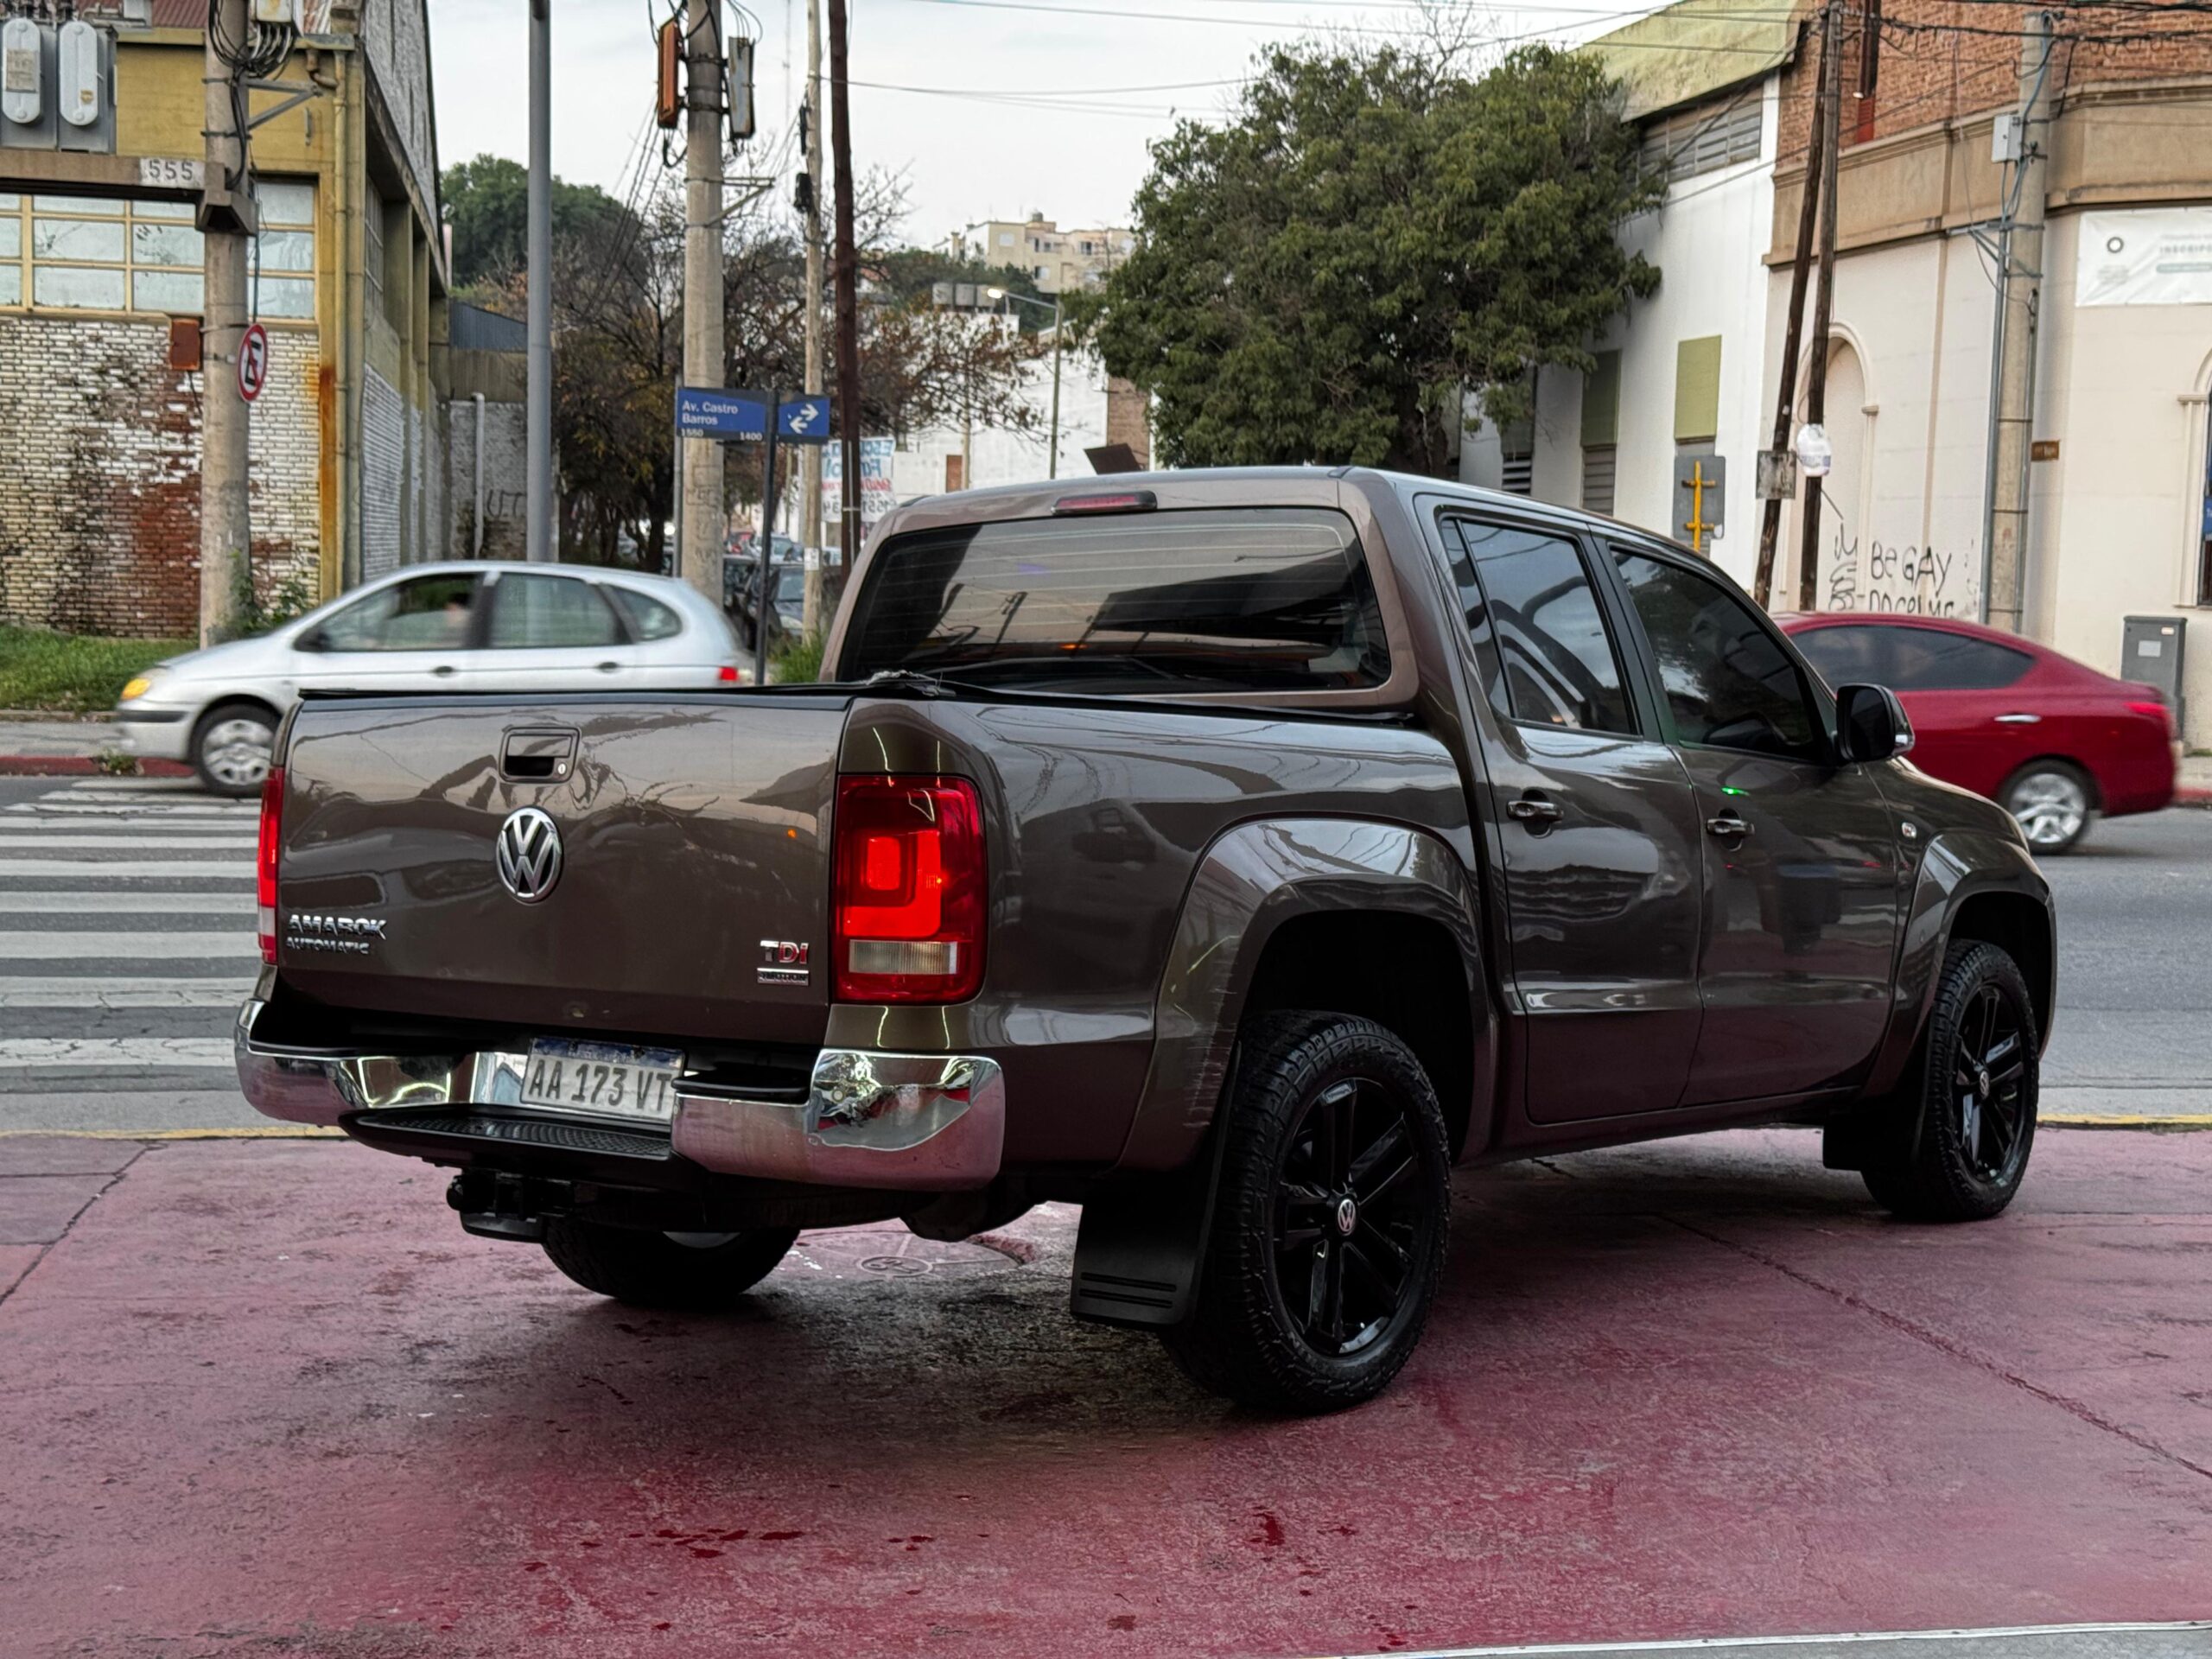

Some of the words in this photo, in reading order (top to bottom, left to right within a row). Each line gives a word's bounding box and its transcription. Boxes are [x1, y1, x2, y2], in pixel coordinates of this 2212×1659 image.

[149, 159, 193, 181] 555
[683, 400, 699, 412] Av.
[702, 401, 738, 414] Castro
[682, 413, 718, 425] Barros
[740, 431, 763, 441] 1400
[288, 914, 387, 940] AMAROK
[760, 940, 809, 964] TDI
[528, 1058, 563, 1100] AA
[571, 1063, 627, 1107] 173
[636, 1070, 672, 1112] VT
